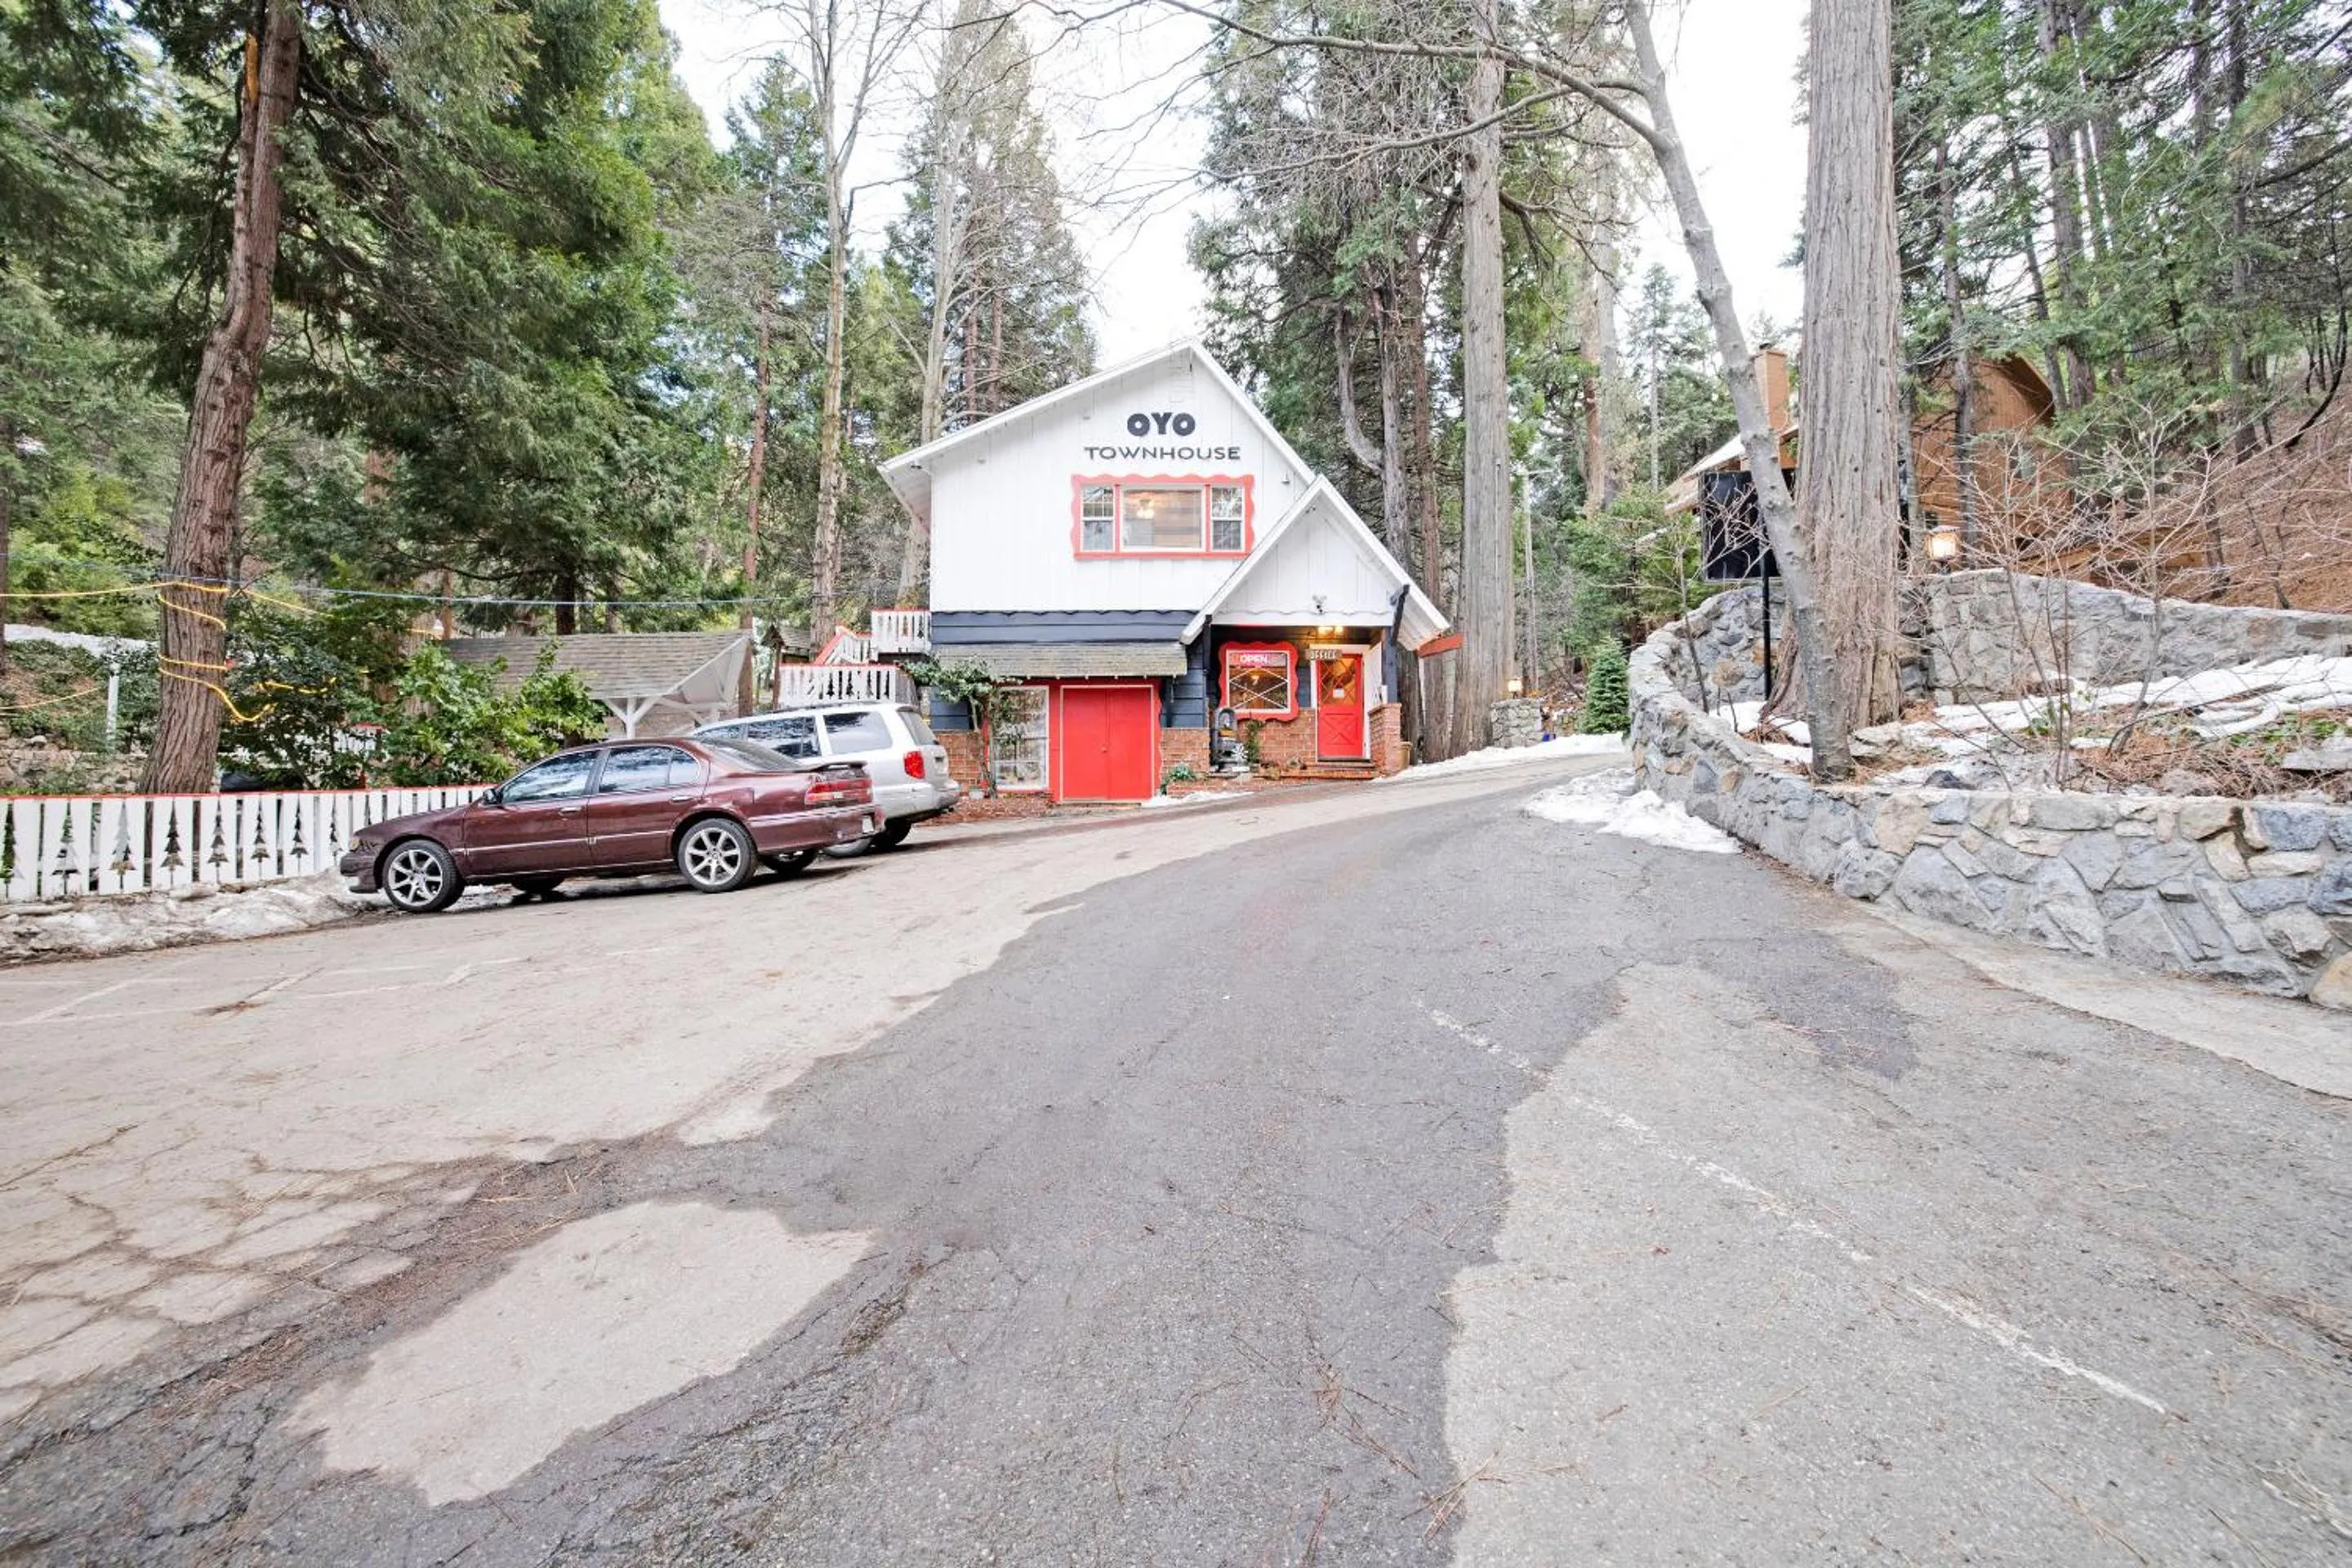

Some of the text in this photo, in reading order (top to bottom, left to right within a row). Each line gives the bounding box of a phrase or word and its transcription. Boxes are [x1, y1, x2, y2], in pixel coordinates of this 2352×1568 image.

[1127, 412, 1196, 437] OYO
[1084, 446, 1241, 461] TOWNHOUSE
[1240, 653, 1267, 664] OPEN
